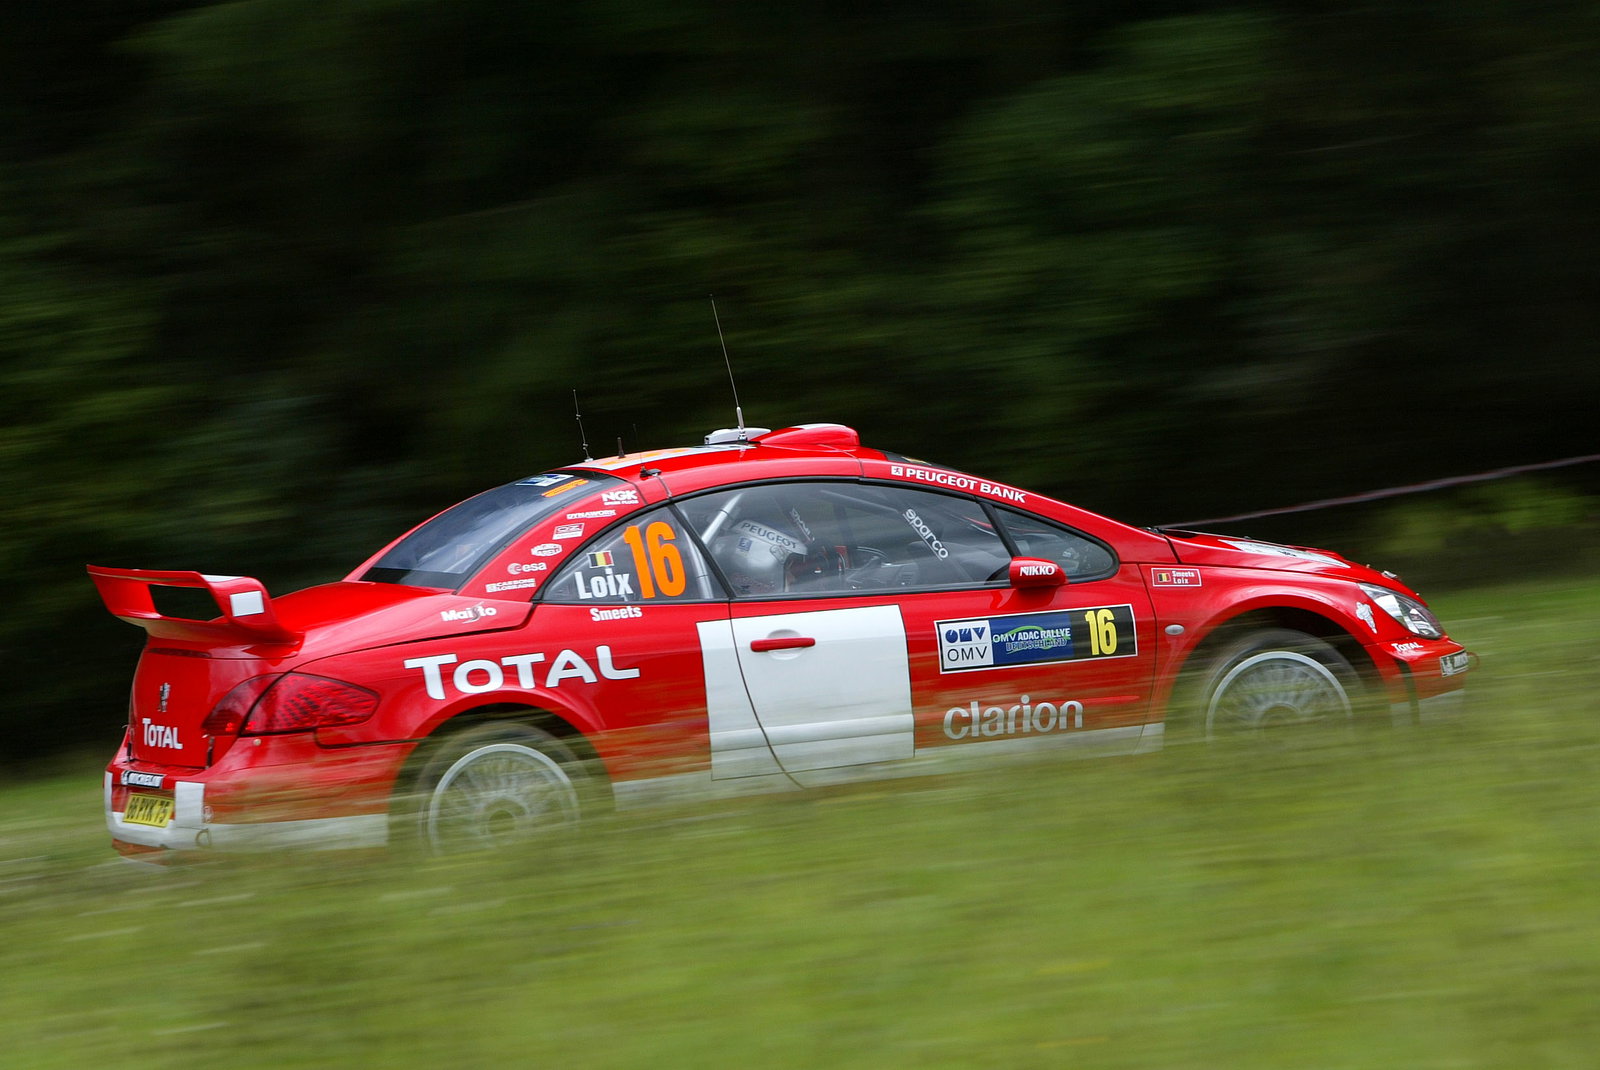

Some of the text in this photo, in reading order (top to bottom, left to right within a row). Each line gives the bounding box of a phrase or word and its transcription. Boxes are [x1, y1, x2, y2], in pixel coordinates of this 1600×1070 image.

[601, 490, 638, 502] NGK
[906, 467, 1027, 503] PEUGEOT BANK
[741, 522, 797, 549] PEUGEOT
[905, 508, 949, 559] sparco
[522, 562, 547, 572] esa
[623, 521, 686, 599] 16
[1019, 565, 1056, 577] NIKKO
[574, 568, 633, 600] Loix
[590, 606, 643, 622] Smeets
[993, 628, 1071, 643] OMV ADAC RALLYE
[1084, 609, 1117, 656] 16
[1391, 642, 1424, 652] TOTAL
[947, 646, 987, 662] OMV
[403, 645, 641, 700] TOTAL
[943, 694, 1083, 740] clarion
[142, 718, 183, 750] TOTAL
